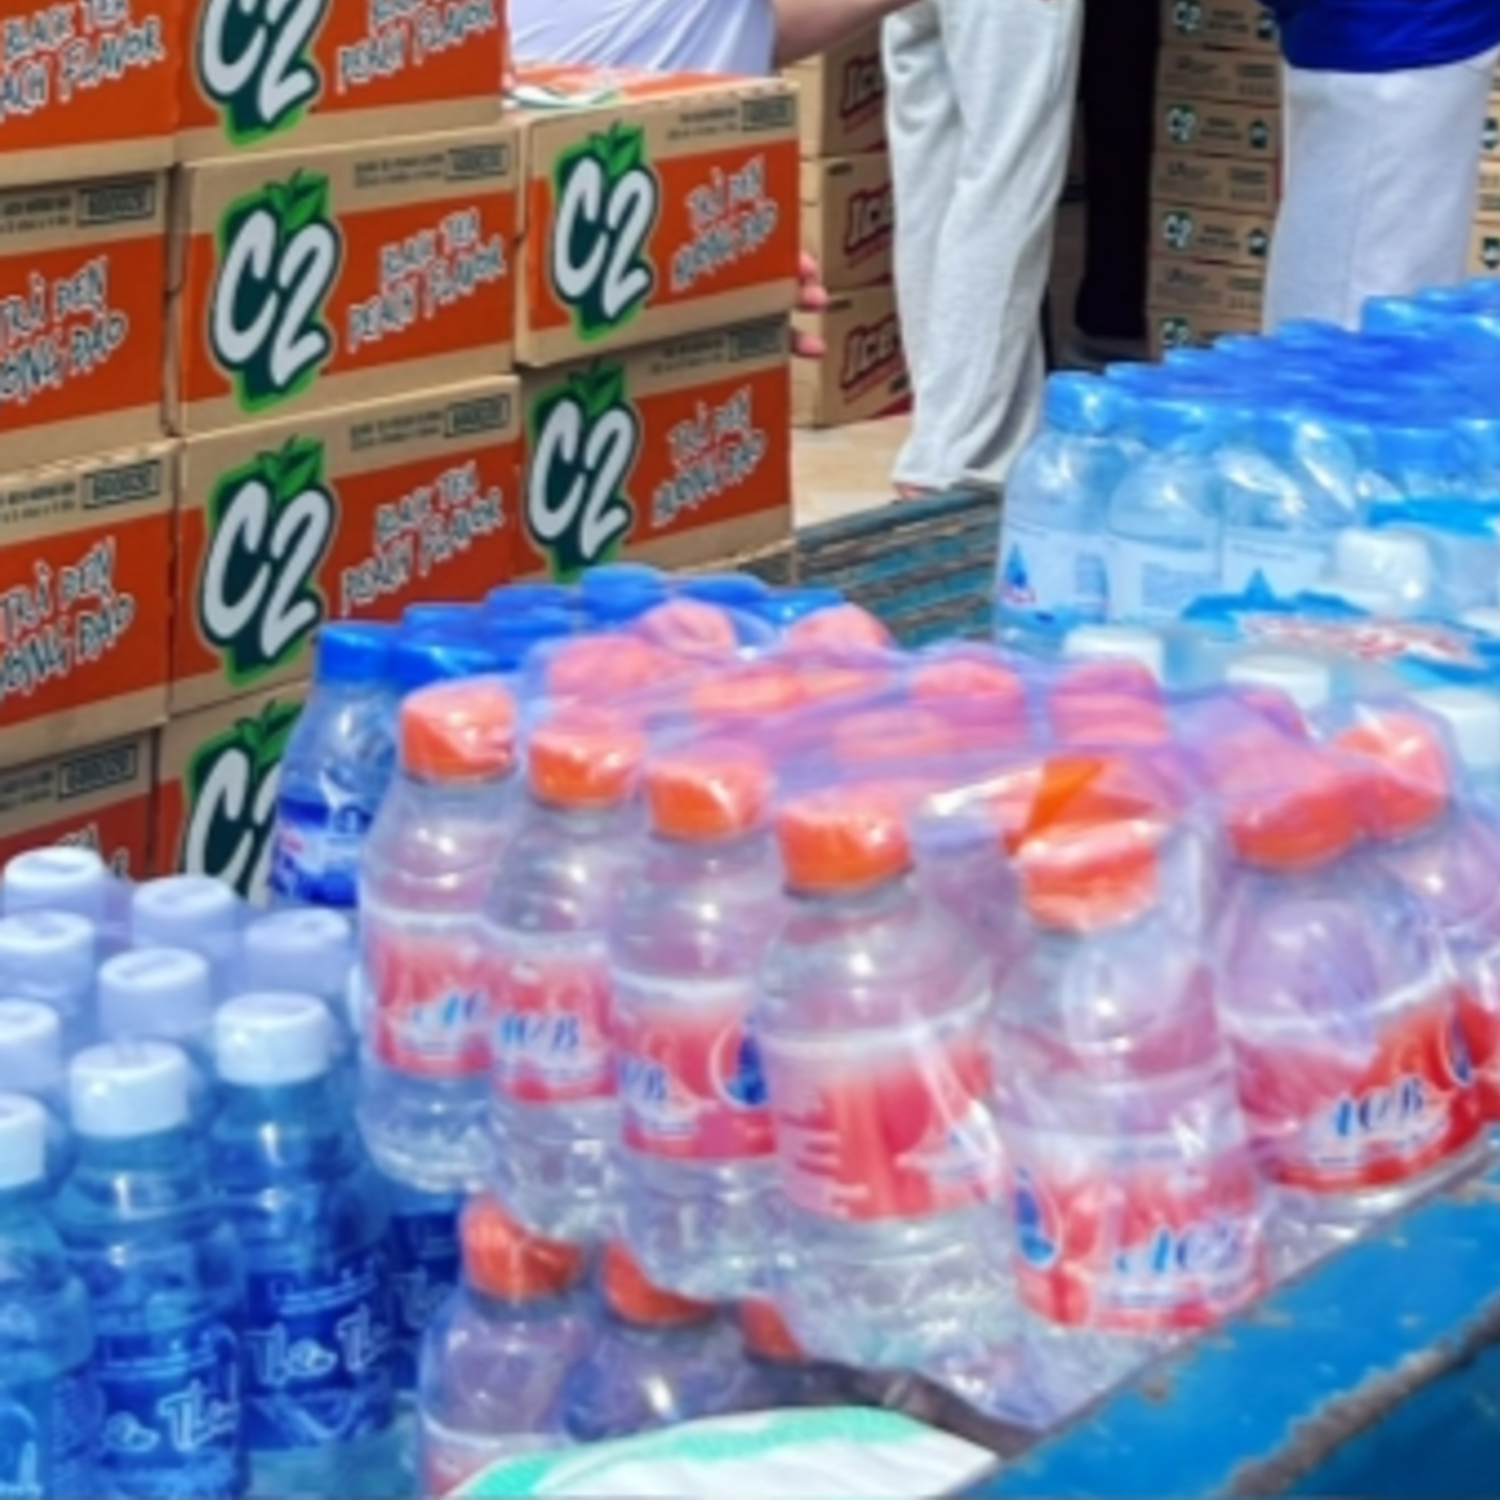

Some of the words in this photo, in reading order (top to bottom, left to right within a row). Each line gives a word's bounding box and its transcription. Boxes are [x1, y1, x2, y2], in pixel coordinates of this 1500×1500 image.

[213, 209, 338, 386] C2
[555, 157, 656, 318] C2
[530, 400, 634, 559] C2
[203, 481, 332, 659] C2
